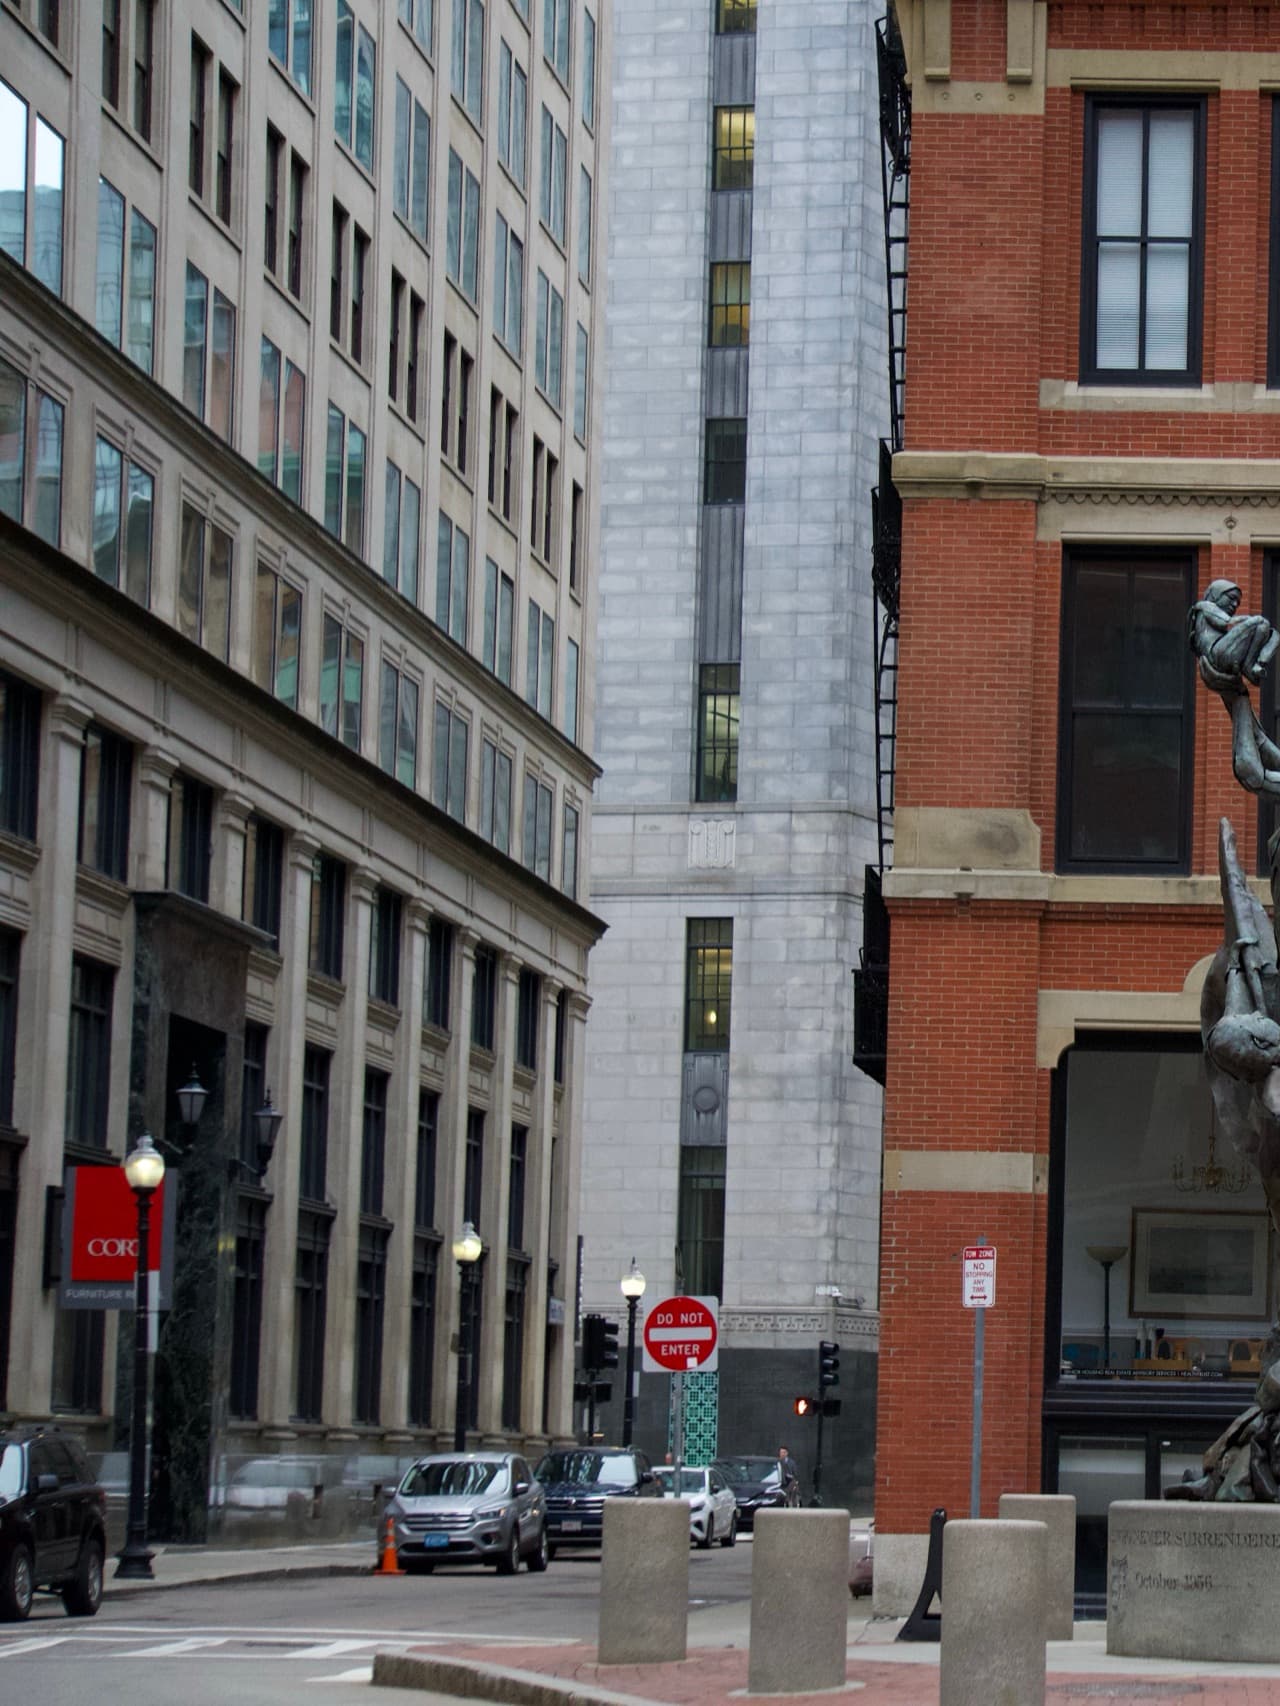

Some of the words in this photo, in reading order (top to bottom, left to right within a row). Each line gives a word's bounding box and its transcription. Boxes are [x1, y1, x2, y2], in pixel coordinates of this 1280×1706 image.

[978, 1250, 994, 1258] ZONE
[973, 1262, 985, 1270] NO
[965, 1270, 993, 1278] STOPPING
[65, 1289, 122, 1300] FURNITURE
[656, 1312, 674, 1325] DO
[680, 1311, 705, 1324] NOT
[660, 1343, 701, 1357] ENTER
